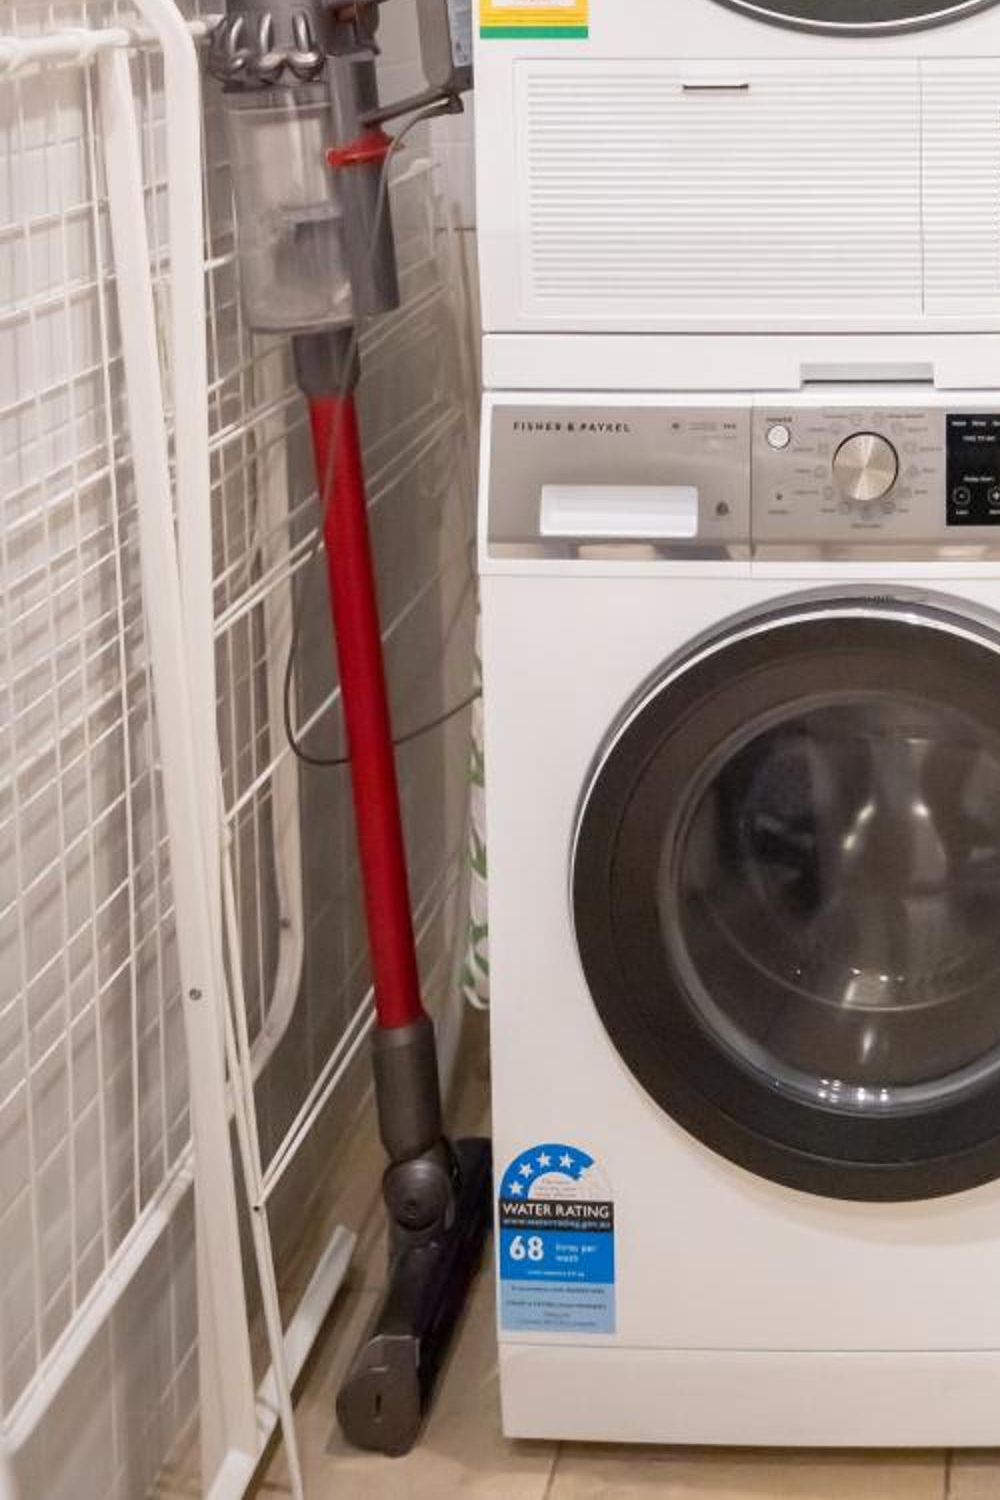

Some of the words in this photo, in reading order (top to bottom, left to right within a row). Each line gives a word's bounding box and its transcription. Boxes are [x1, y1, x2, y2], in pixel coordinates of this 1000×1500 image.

[513, 421, 561, 431] FISHER
[579, 422, 632, 433] PAYKEL
[503, 1203, 551, 1216] WATER
[555, 1205, 610, 1219] RATING
[509, 1235, 544, 1261] 68
